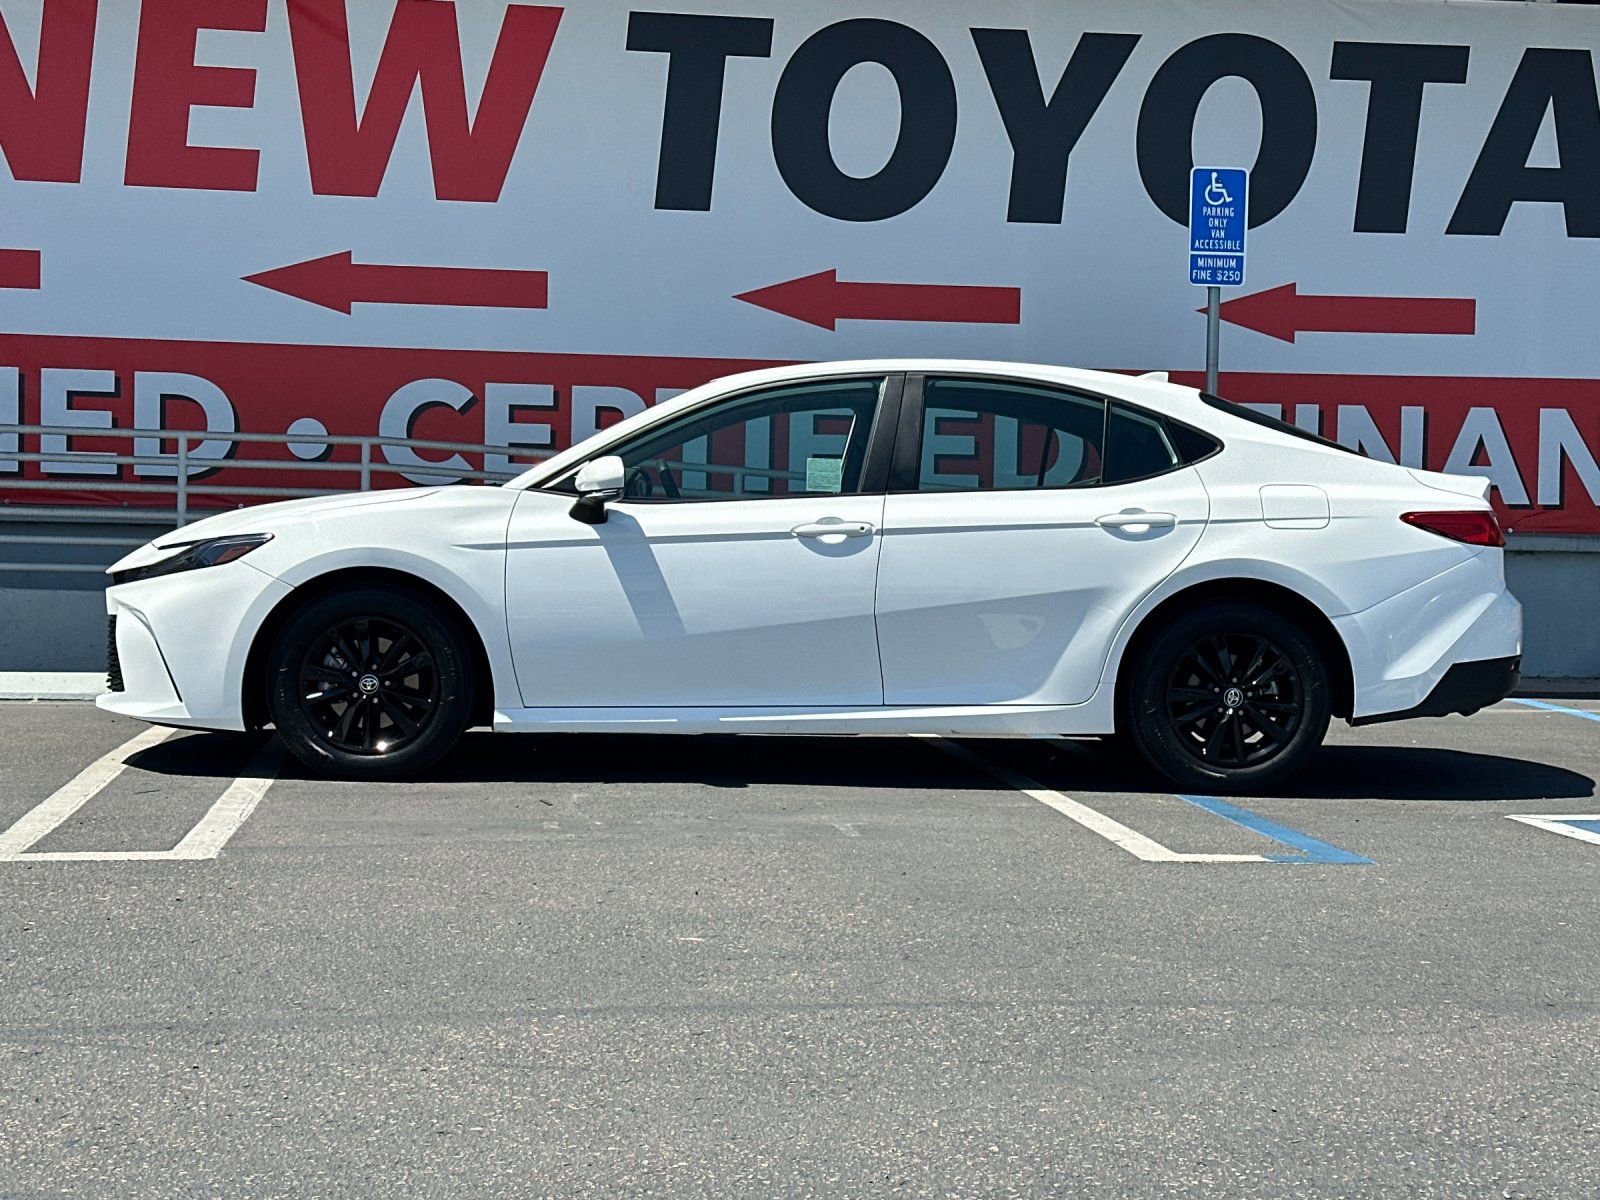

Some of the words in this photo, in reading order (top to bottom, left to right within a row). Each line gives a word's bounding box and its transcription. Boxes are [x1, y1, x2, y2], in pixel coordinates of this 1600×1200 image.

[0, 0, 564, 203] NEW
[627, 11, 1600, 238] TOYOTA
[1202, 206, 1235, 218] PARKING
[1208, 217, 1228, 228] ONLY
[1211, 228, 1225, 239] VAN
[1194, 239, 1241, 250] ACCESSIBLE
[1197, 257, 1237, 269] MINIMUM
[1192, 269, 1212, 280] FINE
[1216, 270, 1241, 282] $250
[379, 378, 1084, 491] CEIFED
[1238, 403, 1600, 506] NAN
